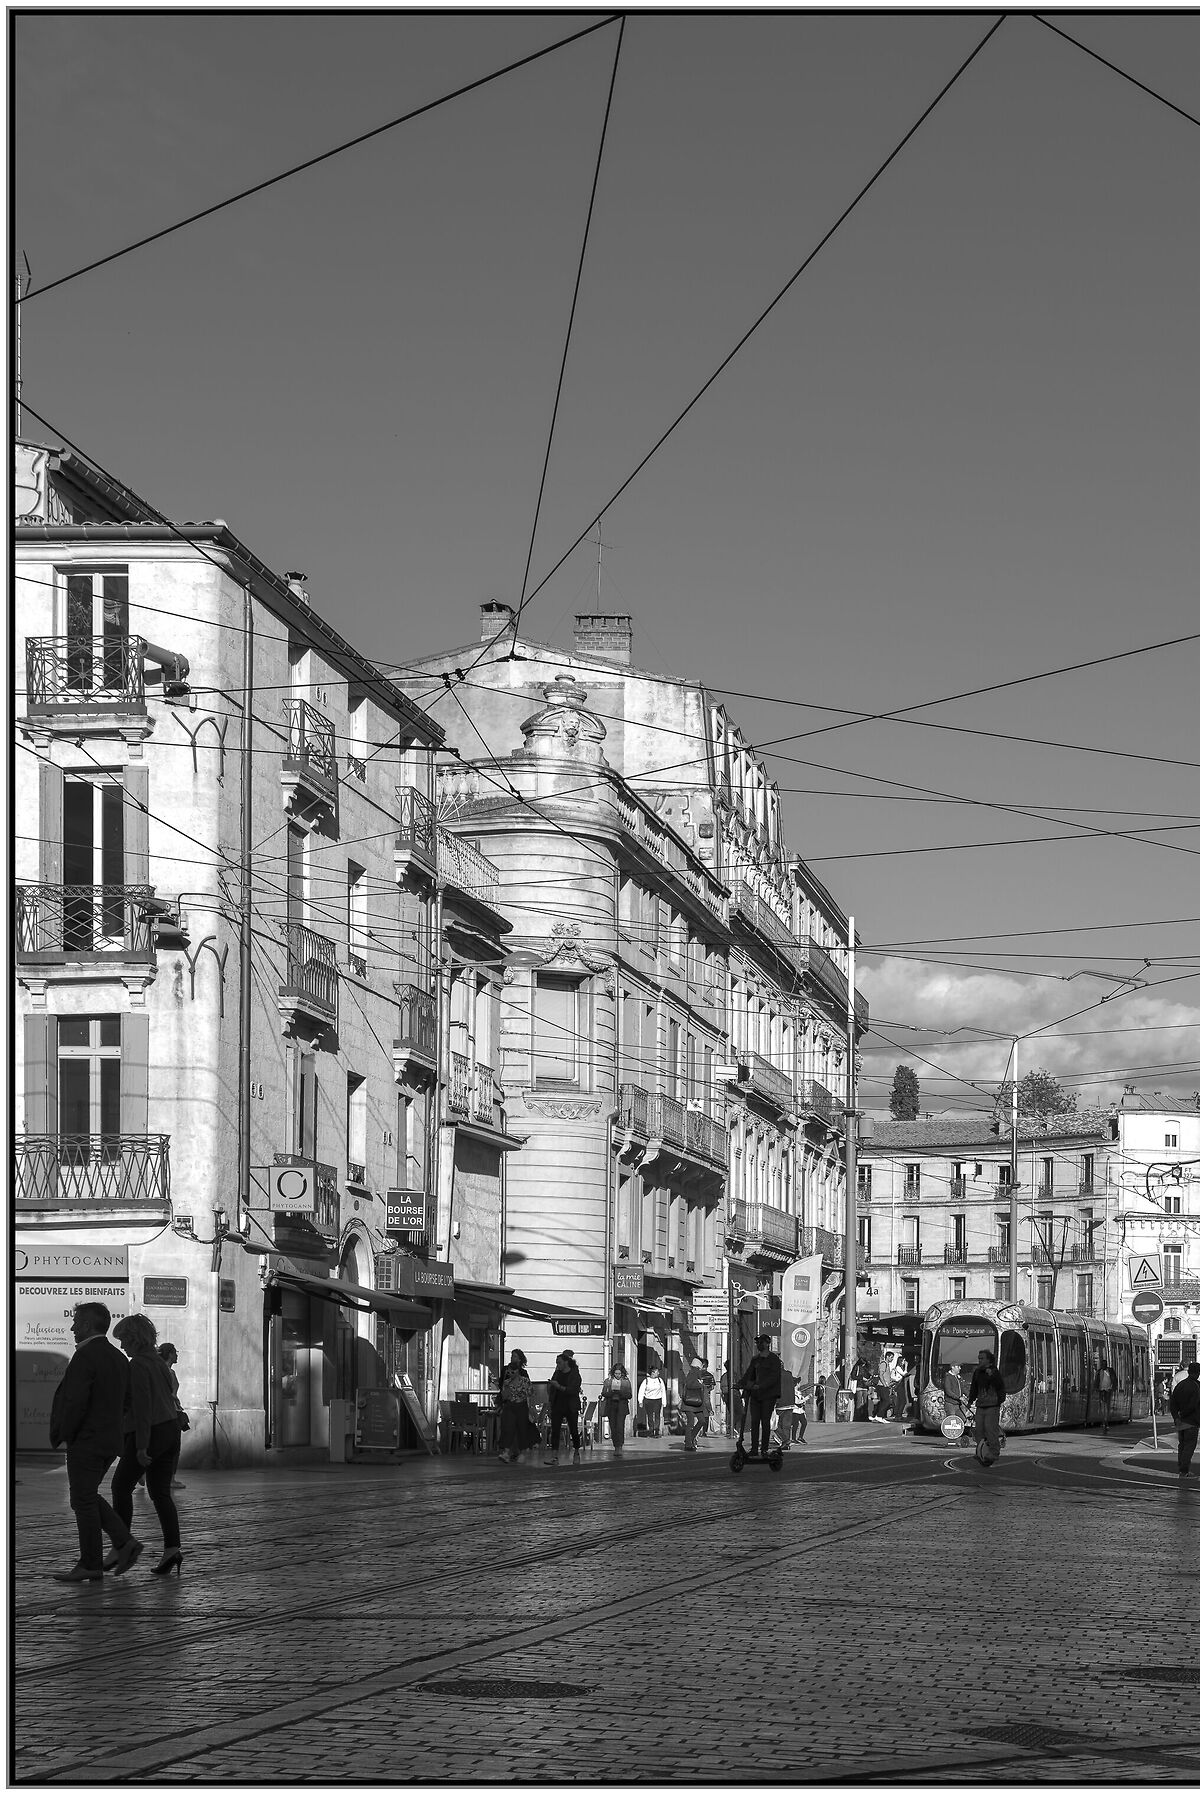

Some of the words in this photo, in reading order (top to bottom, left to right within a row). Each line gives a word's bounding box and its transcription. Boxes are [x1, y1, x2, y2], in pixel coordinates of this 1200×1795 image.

[400, 1196, 412, 1204] LA
[388, 1206, 424, 1215] BOURSE
[388, 1217, 400, 1225] DE
[403, 1217, 423, 1225] L'OR
[34, 1256, 124, 1265] PHYTOCANN
[19, 1287, 68, 1296] DECOUVREZ
[70, 1287, 83, 1296] LES
[85, 1287, 125, 1296] BIENFAITS
[866, 1286, 879, 1296] 4a
